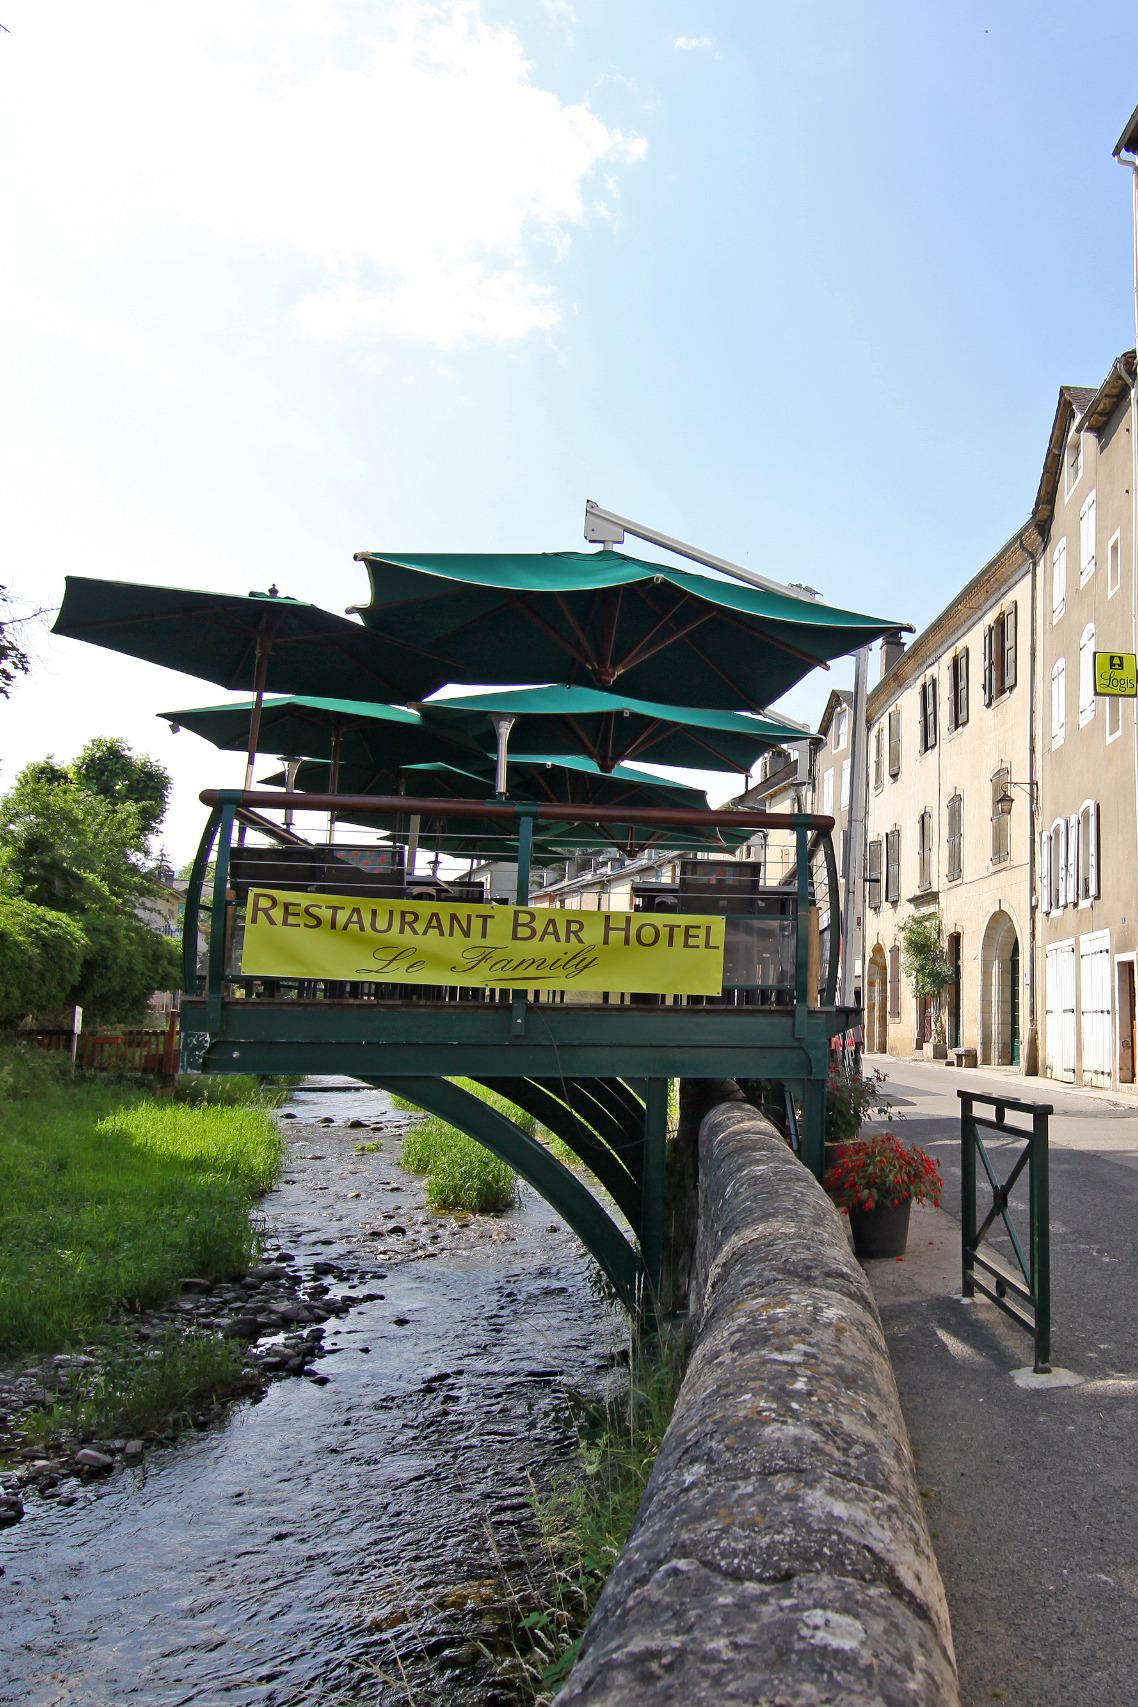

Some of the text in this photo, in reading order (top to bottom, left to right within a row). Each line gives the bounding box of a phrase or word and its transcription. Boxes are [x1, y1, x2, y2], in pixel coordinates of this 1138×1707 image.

[1099, 670, 1135, 692] Logis
[250, 892, 720, 950] RESTAURANT BAR HOTEL
[355, 943, 600, 981] Le Family
